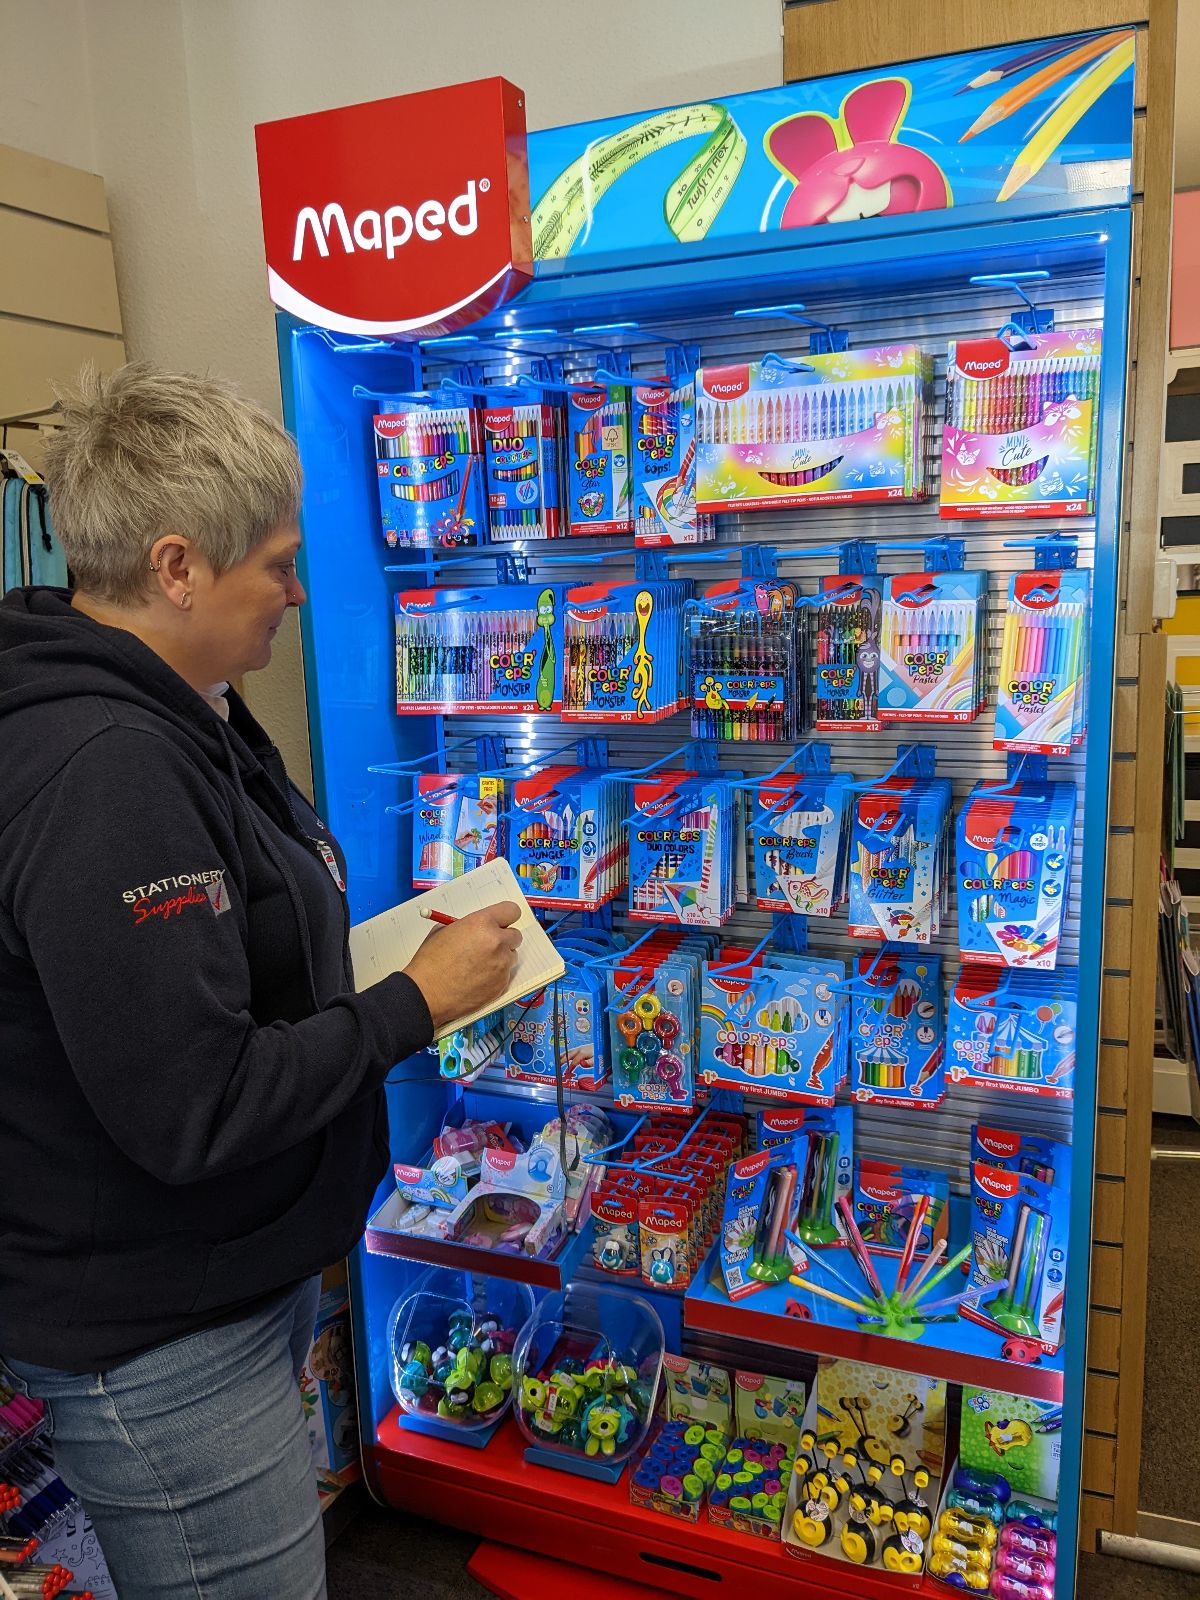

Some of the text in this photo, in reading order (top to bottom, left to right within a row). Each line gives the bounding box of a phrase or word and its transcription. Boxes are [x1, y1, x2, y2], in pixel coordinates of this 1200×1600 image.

[676, 184, 688, 197] 30
[963, 359, 1002, 372] Maped
[711, 381, 743, 394] Maped
[577, 394, 601, 405] Maped
[641, 390, 665, 400] Maped
[377, 418, 406, 430] Maped
[486, 414, 511, 424] Maped
[492, 437, 524, 452] DUO
[1002, 444, 1033, 467] Cute
[378, 465, 389, 475] 36
[887, 488, 903, 498] x24
[1065, 503, 1082, 512] x24
[615, 522, 628, 531] x12
[683, 533, 695, 542] x12
[912, 674, 939, 685] Pastel
[495, 682, 531, 698] MONSTER
[592, 694, 626, 709] MONSTER
[620, 713, 632, 721] x12
[953, 712, 968, 720] x10
[866, 722, 879, 731] x12
[1051, 746, 1067, 755] x12
[646, 842, 696, 855] DUO COLORS
[528, 849, 566, 861] JUNGLE
[785, 848, 814, 861] Brush
[121, 868, 226, 904] STATIONERY
[867, 888, 905, 901] Glitter
[998, 892, 1037, 908] Magic
[583, 902, 595, 910] x12
[815, 907, 828, 915] x10
[916, 933, 927, 941] x8
[1036, 959, 1051, 968] x10
[703, 1070, 718, 1084] 1+
[951, 1066, 969, 1083] 1+
[739, 1084, 788, 1098] my first JUMBO
[999, 1082, 1014, 1090] WAX
[1015, 1084, 1040, 1094] JUMBO
[856, 1088, 874, 1101] 2+
[1055, 1090, 1072, 1098] x12
[815, 1097, 829, 1106] x12
[922, 1101, 935, 1109] x12
[769, 1117, 800, 1127] Maped
[983, 1137, 1013, 1151] Maped
[490, 1156, 512, 1167] Maped
[739, 1158, 766, 1174] Maped
[396, 1168, 420, 1179] Maped
[981, 1176, 1012, 1192] Maped
[866, 1186, 897, 1197] Maped
[596, 1205, 633, 1219] Maped
[645, 1216, 683, 1228] Maped
[796, 1262, 807, 1272] x12
[1040, 1343, 1053, 1353] x12
[739, 1374, 762, 1385] Maped
[711, 1506, 731, 1517] Maped
